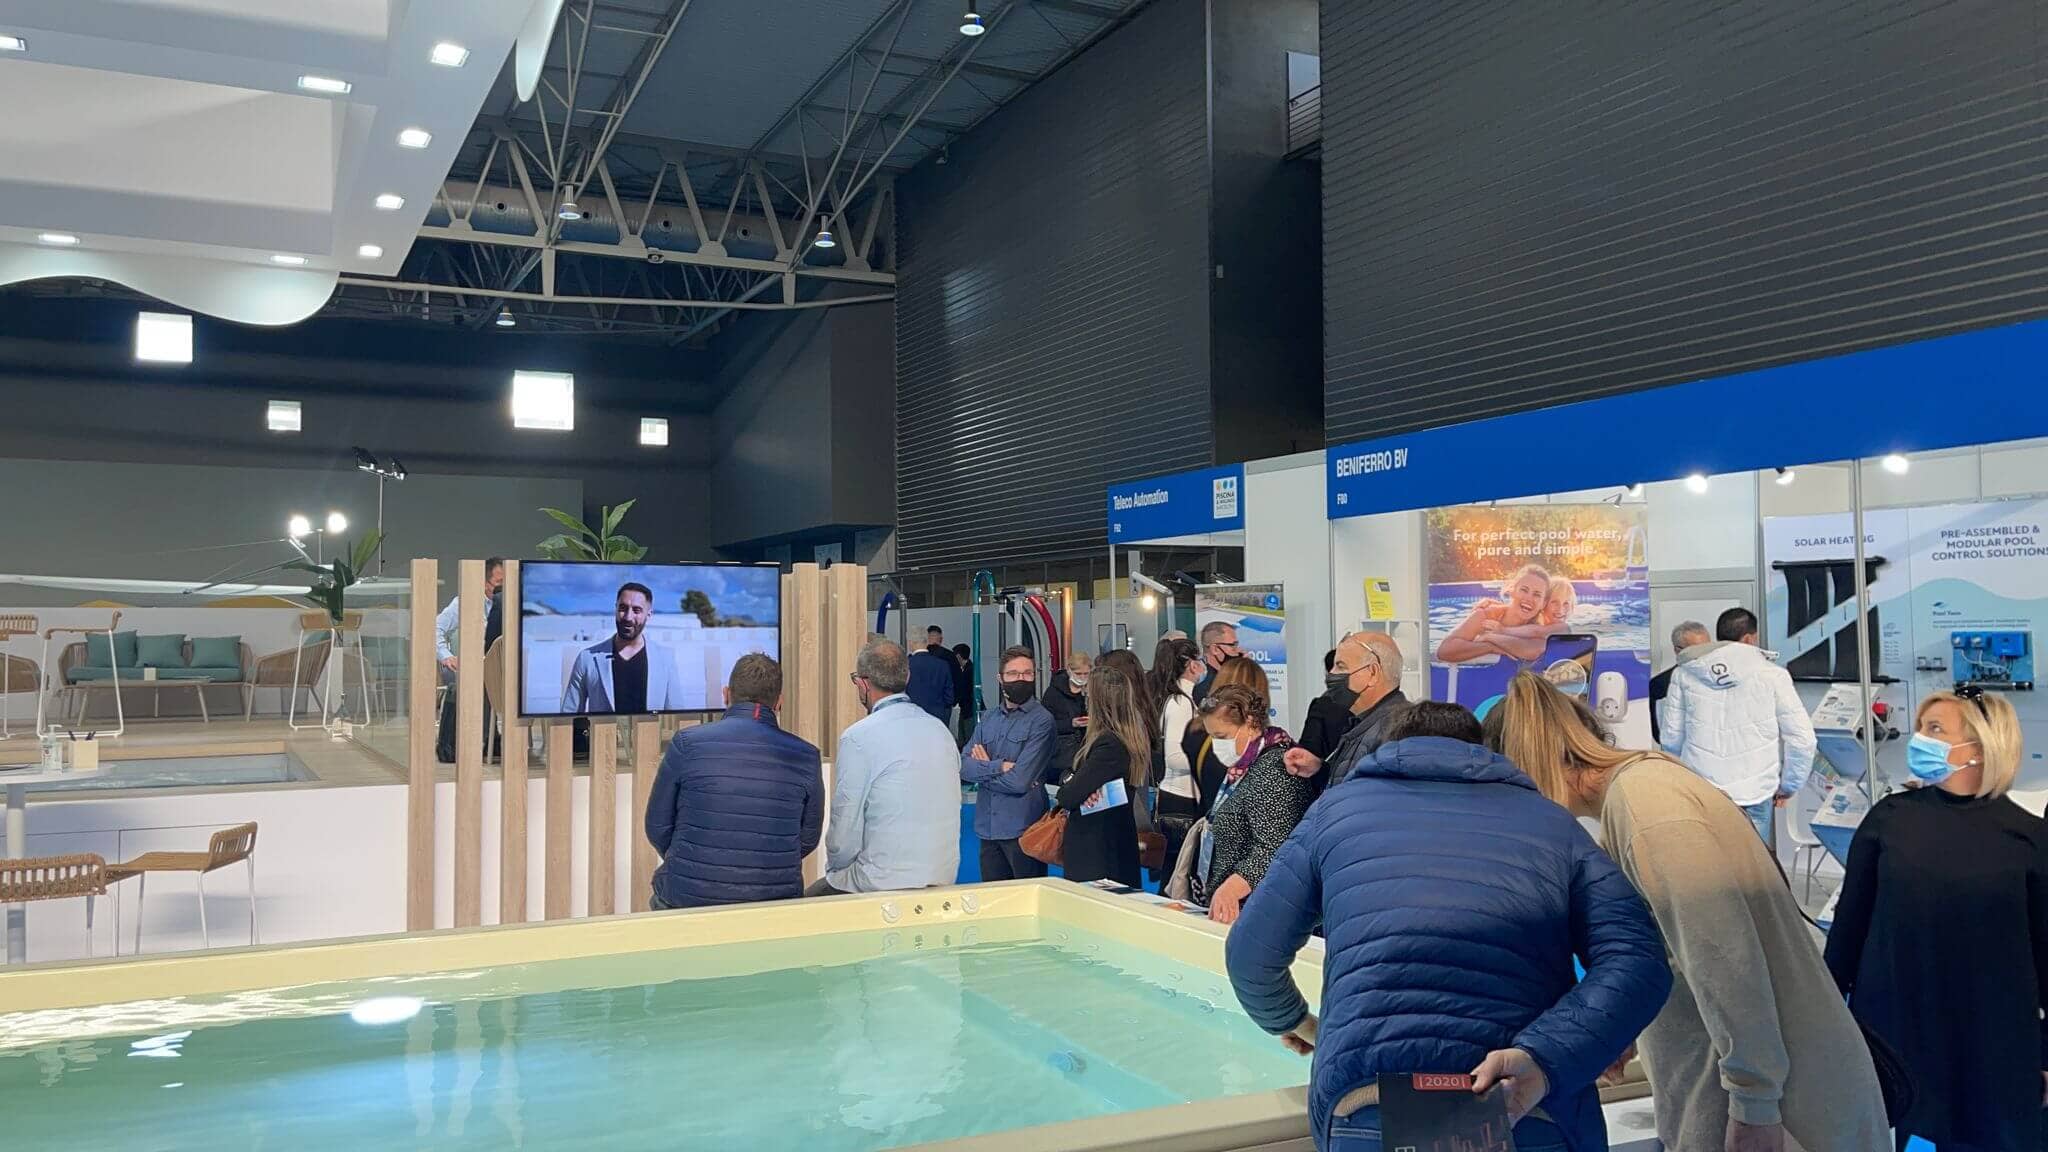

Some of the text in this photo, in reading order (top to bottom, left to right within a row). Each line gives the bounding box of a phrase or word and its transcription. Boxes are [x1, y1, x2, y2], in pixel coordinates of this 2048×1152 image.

[1336, 447, 1408, 478] BENIFERRO BV
[1113, 489, 1169, 511] Teleco Automation
[1453, 527, 1622, 545] For perfect pool water,
[1941, 525, 2040, 538] PRE-ASSEMBLED &
[1794, 534, 1875, 547] SOLAR HEATG
[1946, 537, 2036, 549] MODULAR POOL
[1477, 542, 1598, 559] pure and simple.
[1931, 551, 1985, 561] CONTROL
[1248, 651, 1271, 661] OOL
